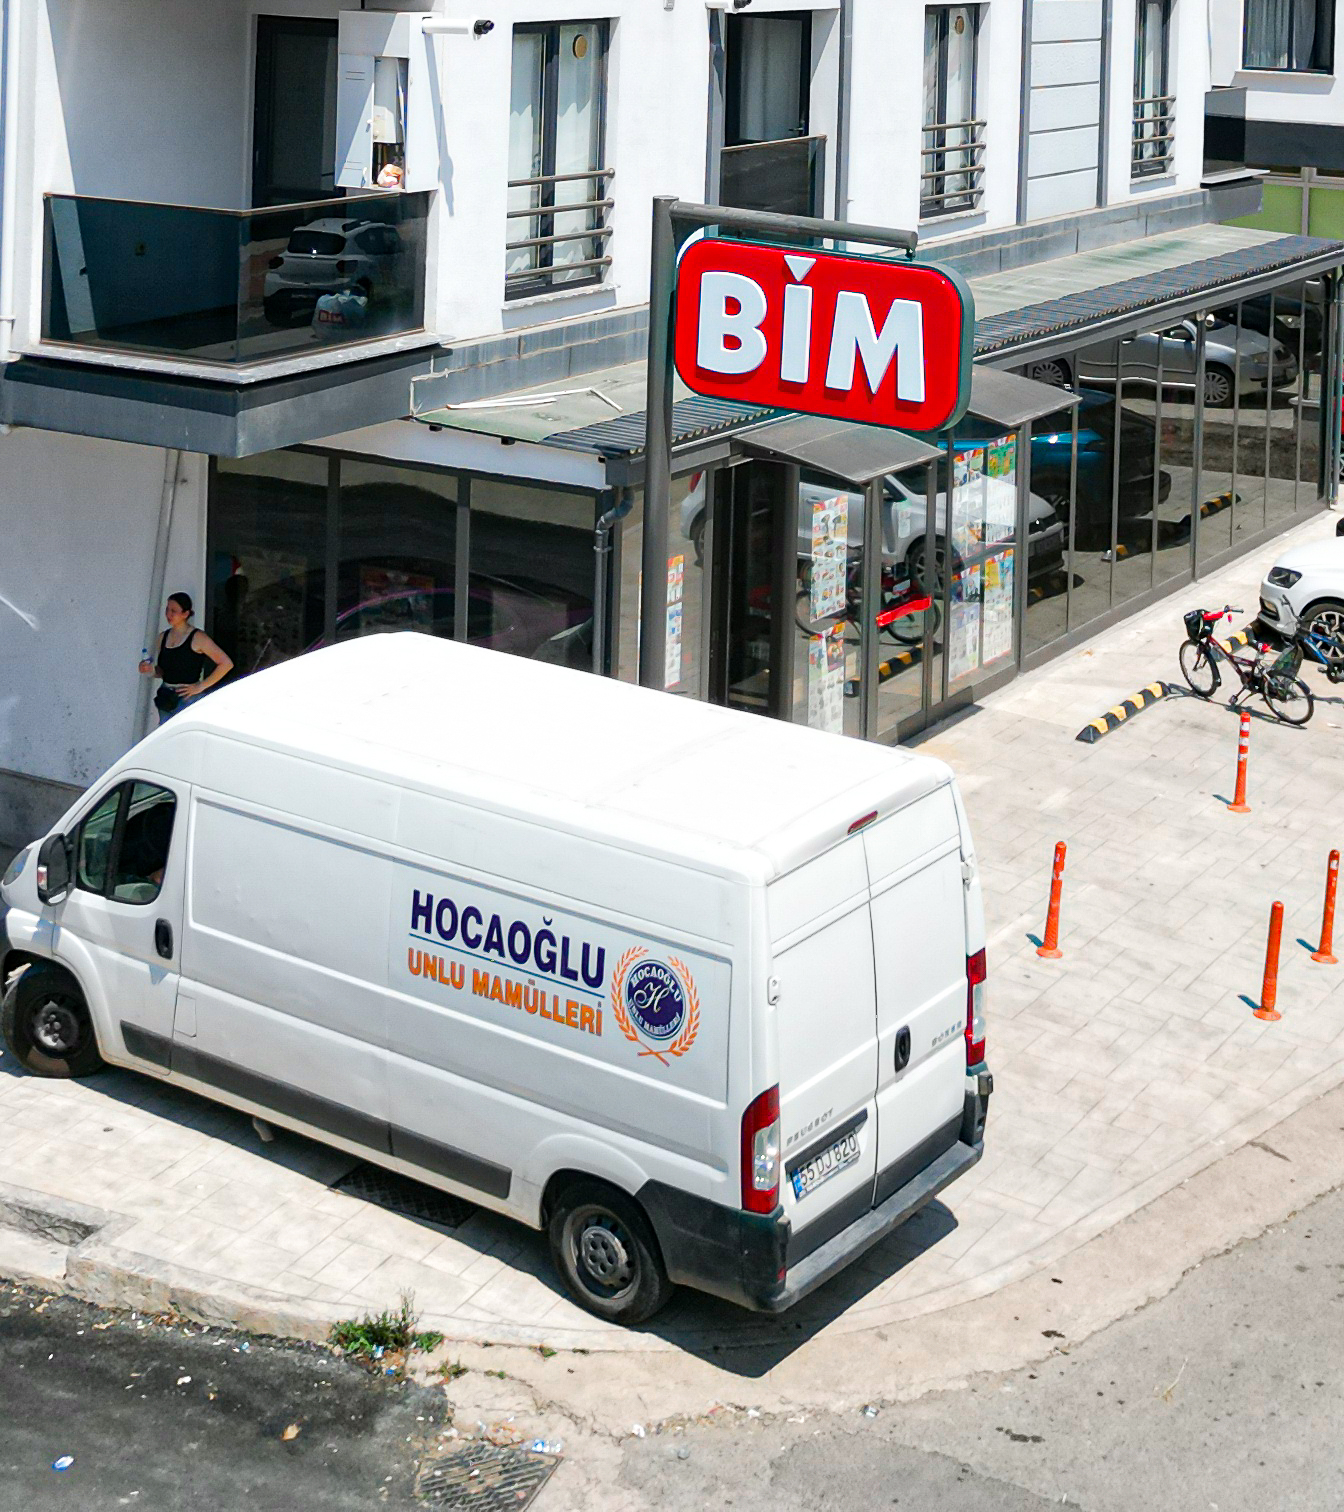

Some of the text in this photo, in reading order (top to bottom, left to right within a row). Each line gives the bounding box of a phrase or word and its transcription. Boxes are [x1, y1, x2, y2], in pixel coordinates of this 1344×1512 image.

[696, 254, 926, 403] BİM
[411, 889, 605, 988] HOCAOĞLU
[408, 947, 603, 1037] UNLU MAMÜLLERİ
[800, 1133, 858, 1186] 55 DJ 820
